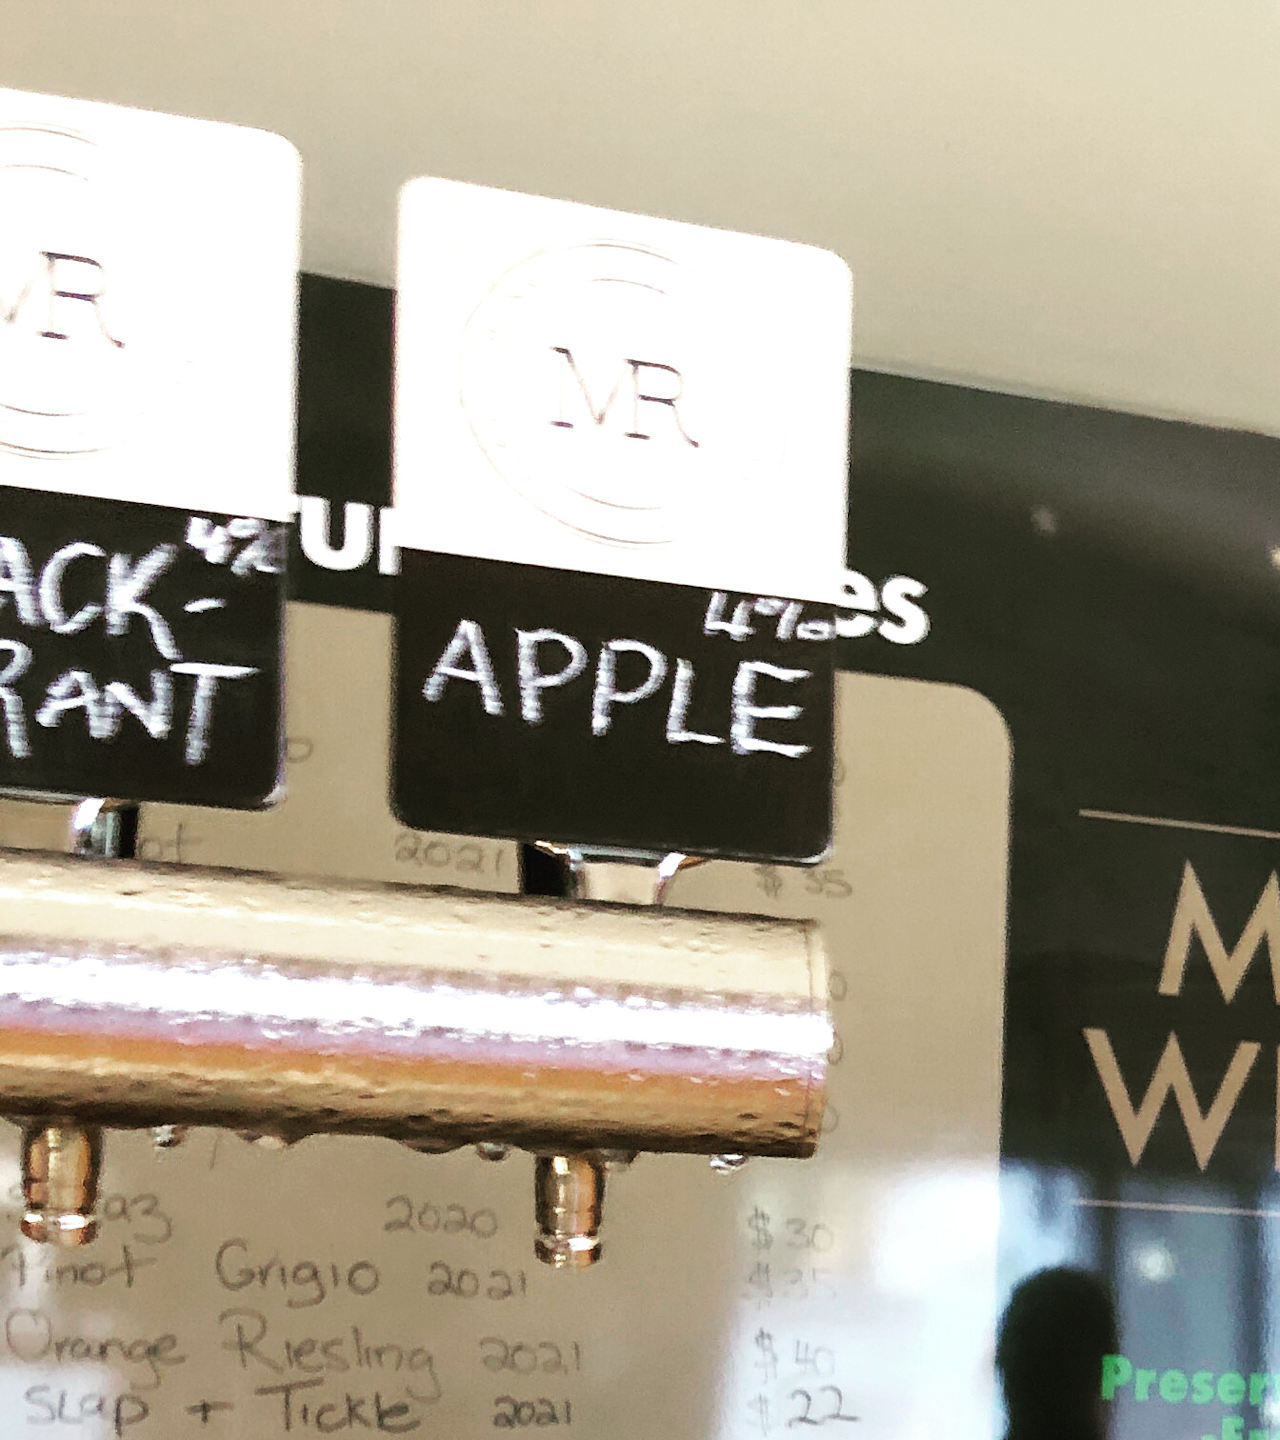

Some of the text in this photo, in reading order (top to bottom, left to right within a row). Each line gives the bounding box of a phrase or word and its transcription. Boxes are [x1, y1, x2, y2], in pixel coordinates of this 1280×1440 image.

[703, 591, 837, 641] 4%
[422, 618, 814, 759] APPLE
[384, 1194, 499, 1240] 2020
[214, 1237, 381, 1310] Grigio
[428, 1259, 528, 1301] 2021
[4, 1307, 187, 1393] Orange
[217, 1306, 444, 1402] Riesling
[479, 1336, 582, 1377] 2021
[186, 1399, 235, 1424] +
[254, 1376, 423, 1435] Tickle
[493, 1395, 573, 1430] 2021
